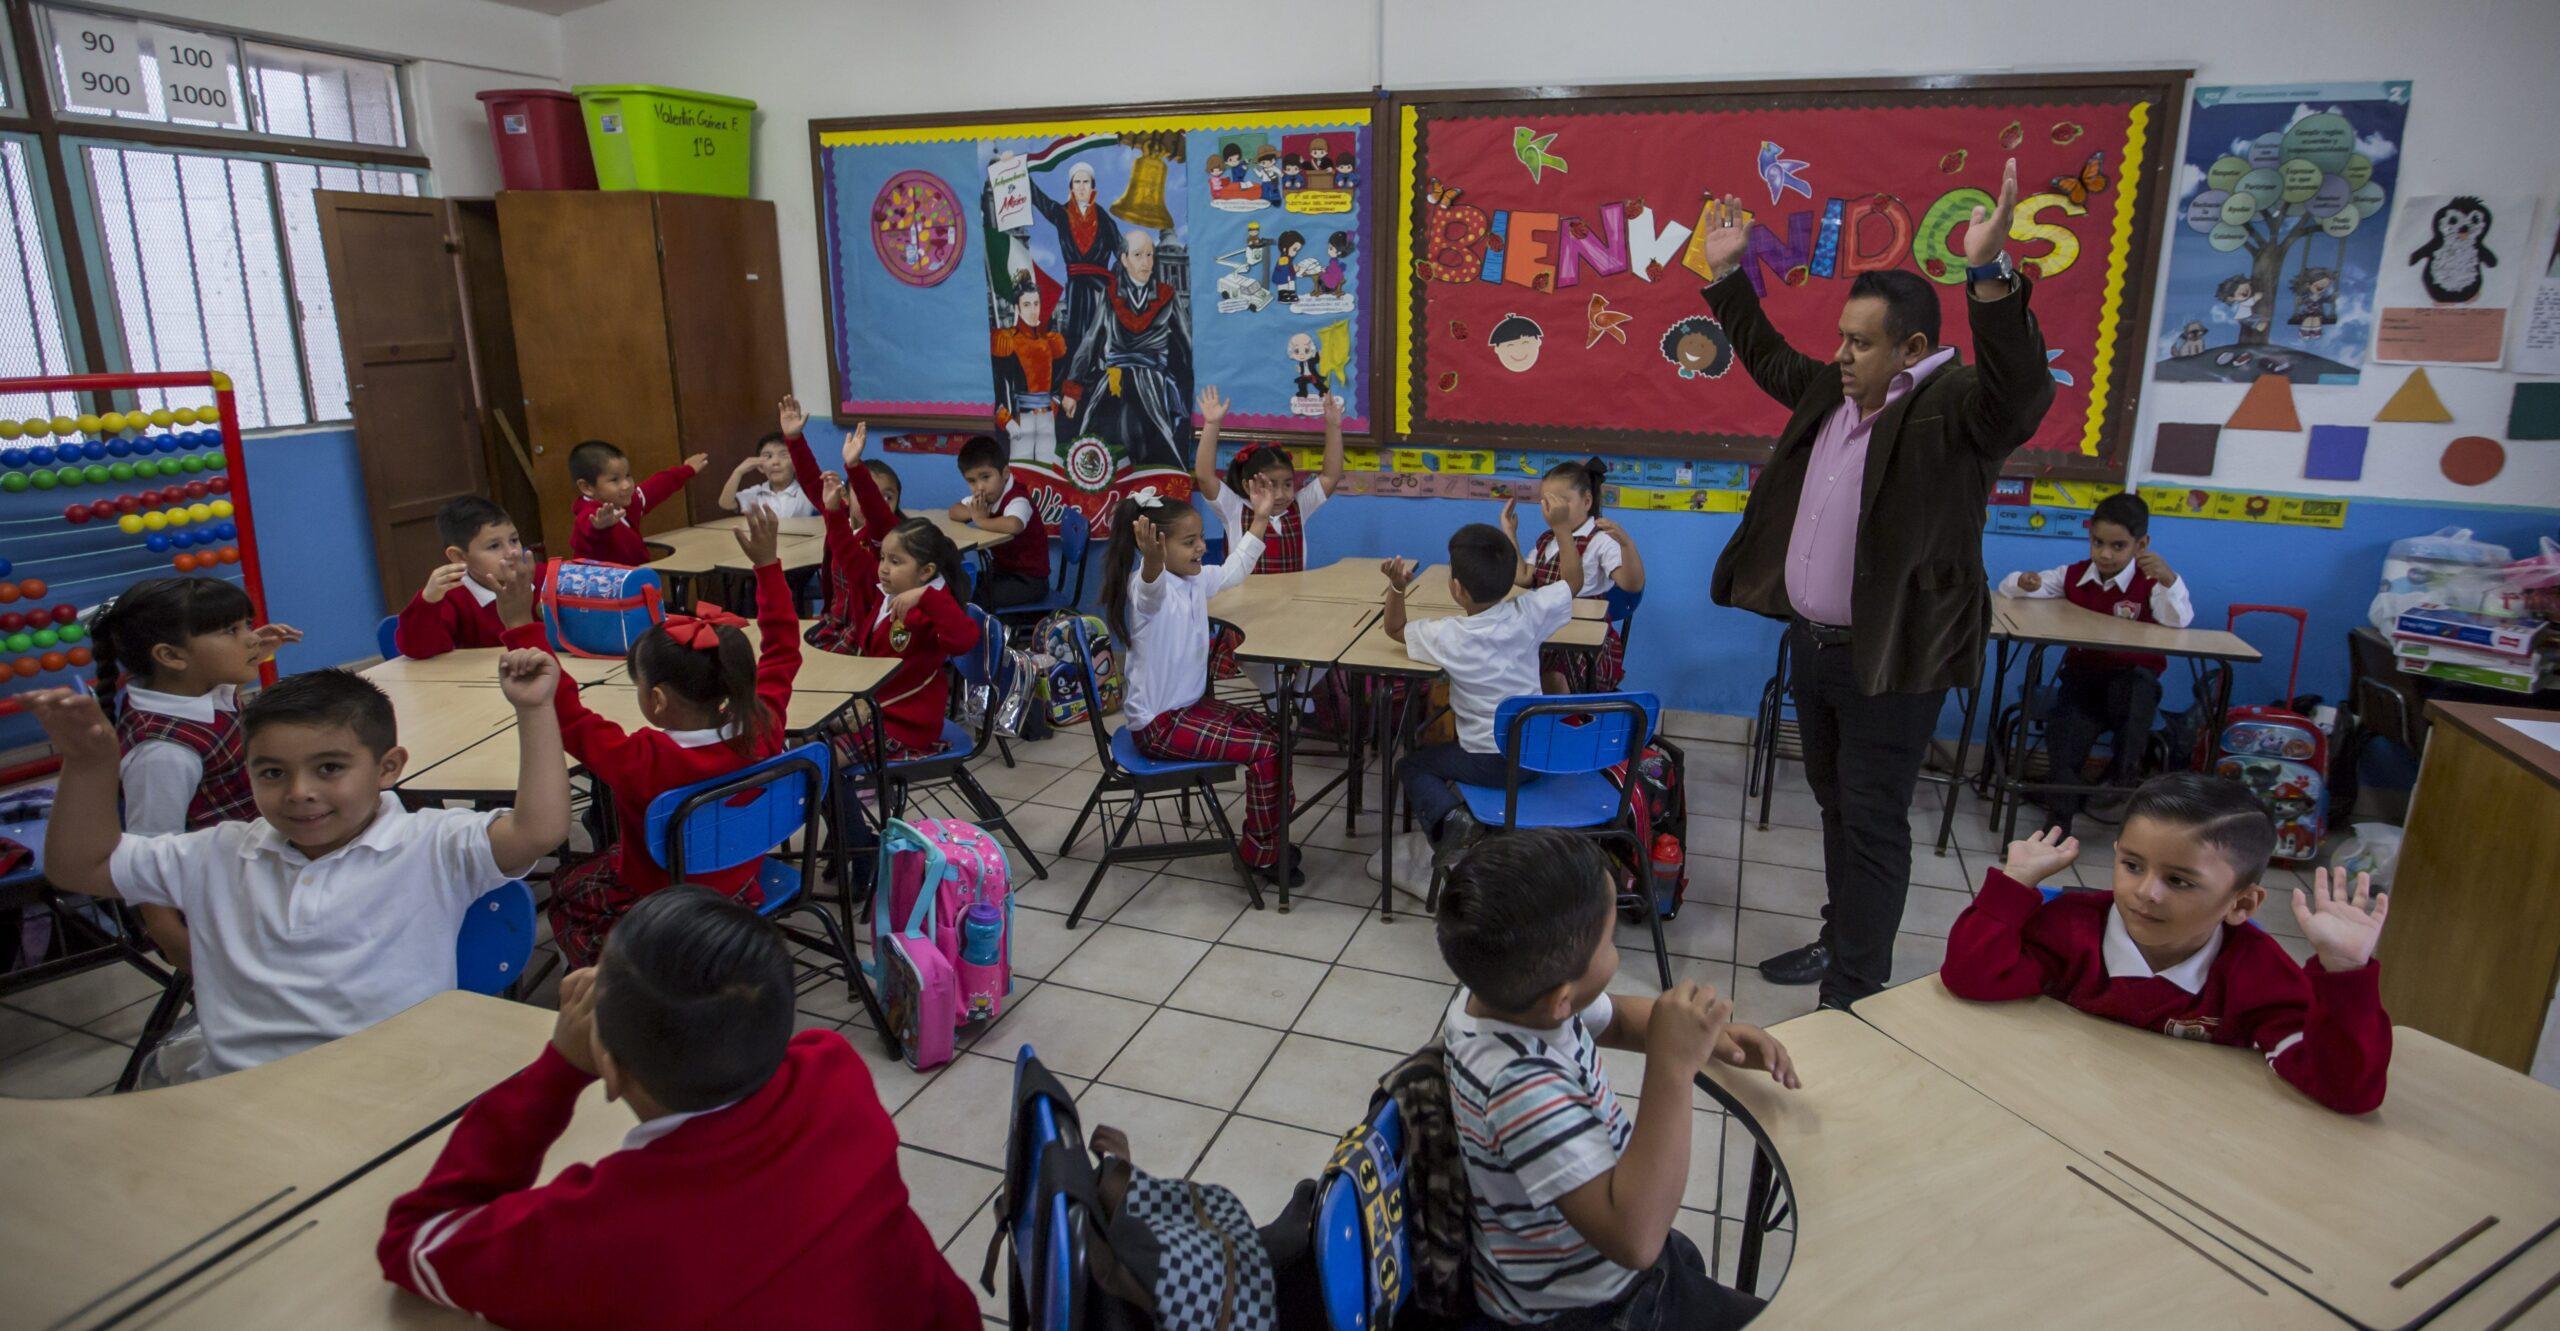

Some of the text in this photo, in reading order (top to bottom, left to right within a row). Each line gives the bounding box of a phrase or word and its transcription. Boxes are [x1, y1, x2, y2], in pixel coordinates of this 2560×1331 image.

[82, 31, 114, 53] 90
[170, 46, 213, 68] 100
[82, 72, 131, 95] 900
[170, 84, 227, 107] 1000
